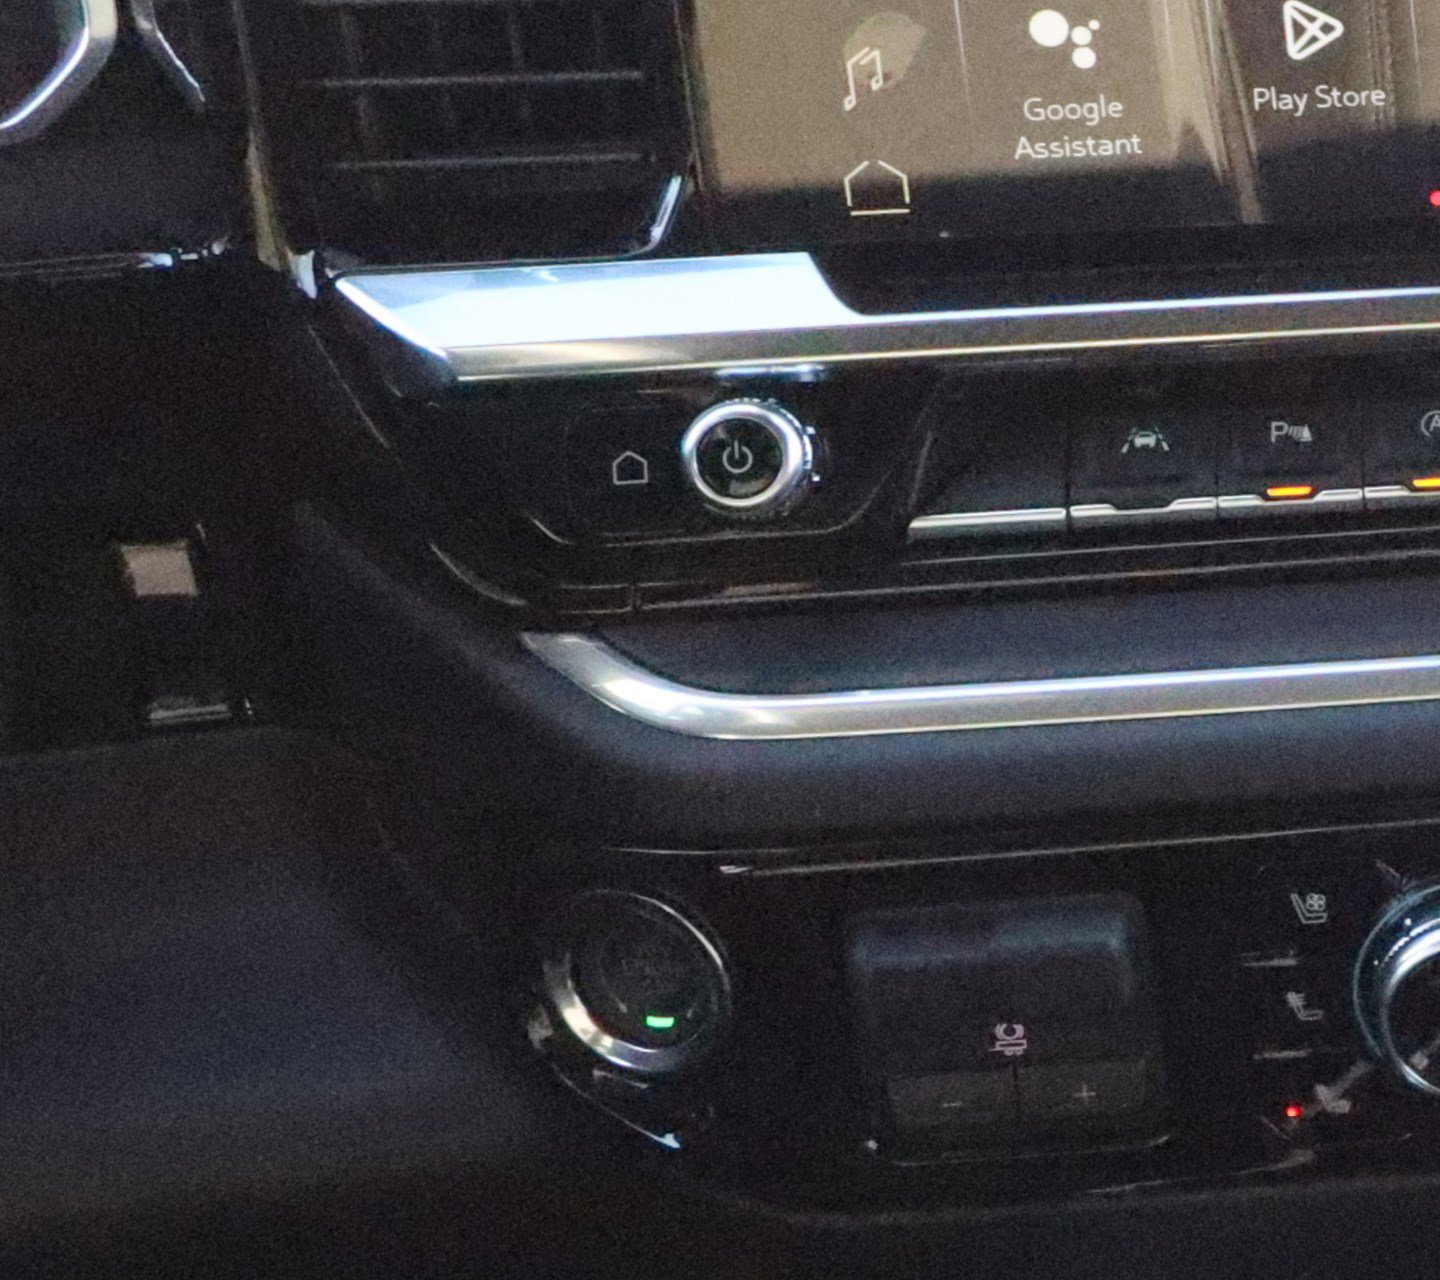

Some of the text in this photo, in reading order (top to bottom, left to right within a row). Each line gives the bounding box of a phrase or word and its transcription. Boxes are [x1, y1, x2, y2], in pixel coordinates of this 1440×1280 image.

[1023, 94, 1124, 126] Google
[1253, 82, 1386, 115] Play Store
[1013, 131, 1143, 160] Assistant
[1271, 421, 1288, 442] P
